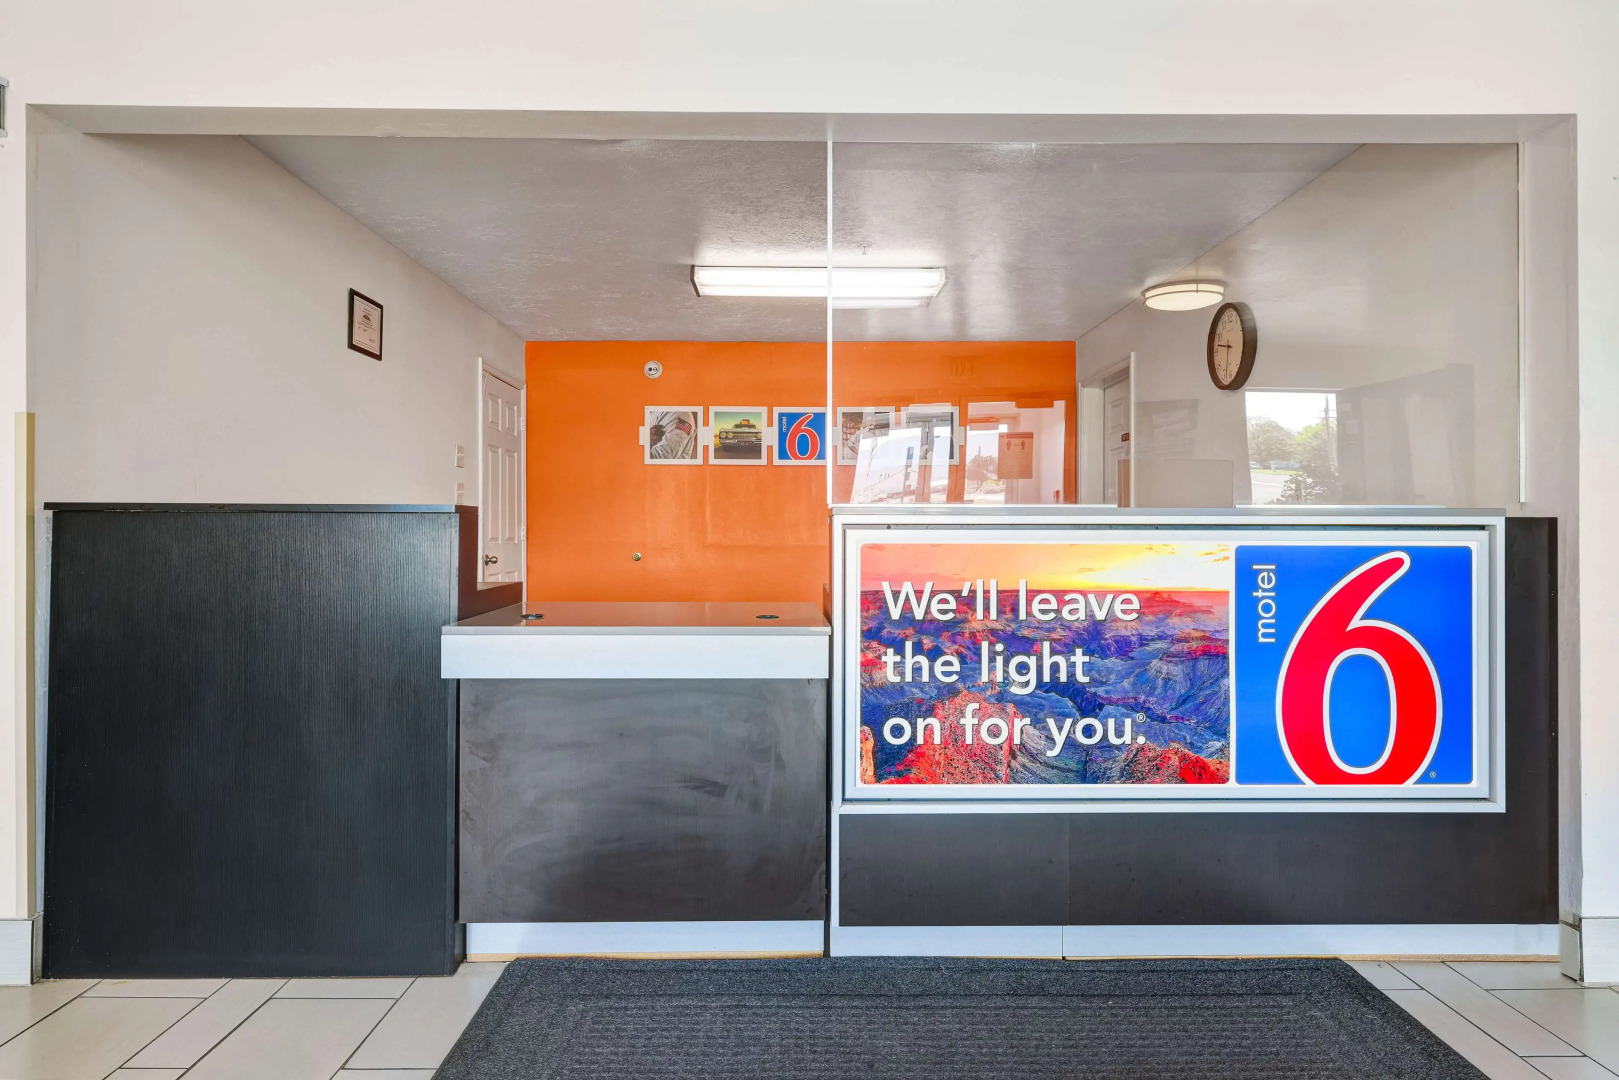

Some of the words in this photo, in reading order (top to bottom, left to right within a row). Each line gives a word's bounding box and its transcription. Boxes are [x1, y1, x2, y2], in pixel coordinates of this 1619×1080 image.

[787, 414, 820, 460] 6
[1018, 579, 1141, 621] leave
[882, 643, 961, 683] the
[981, 642, 1091, 695] light
[1252, 564, 1277, 643] motel
[1276, 550, 1443, 784] 6
[882, 716, 942, 745] on
[960, 703, 1031, 745] for
